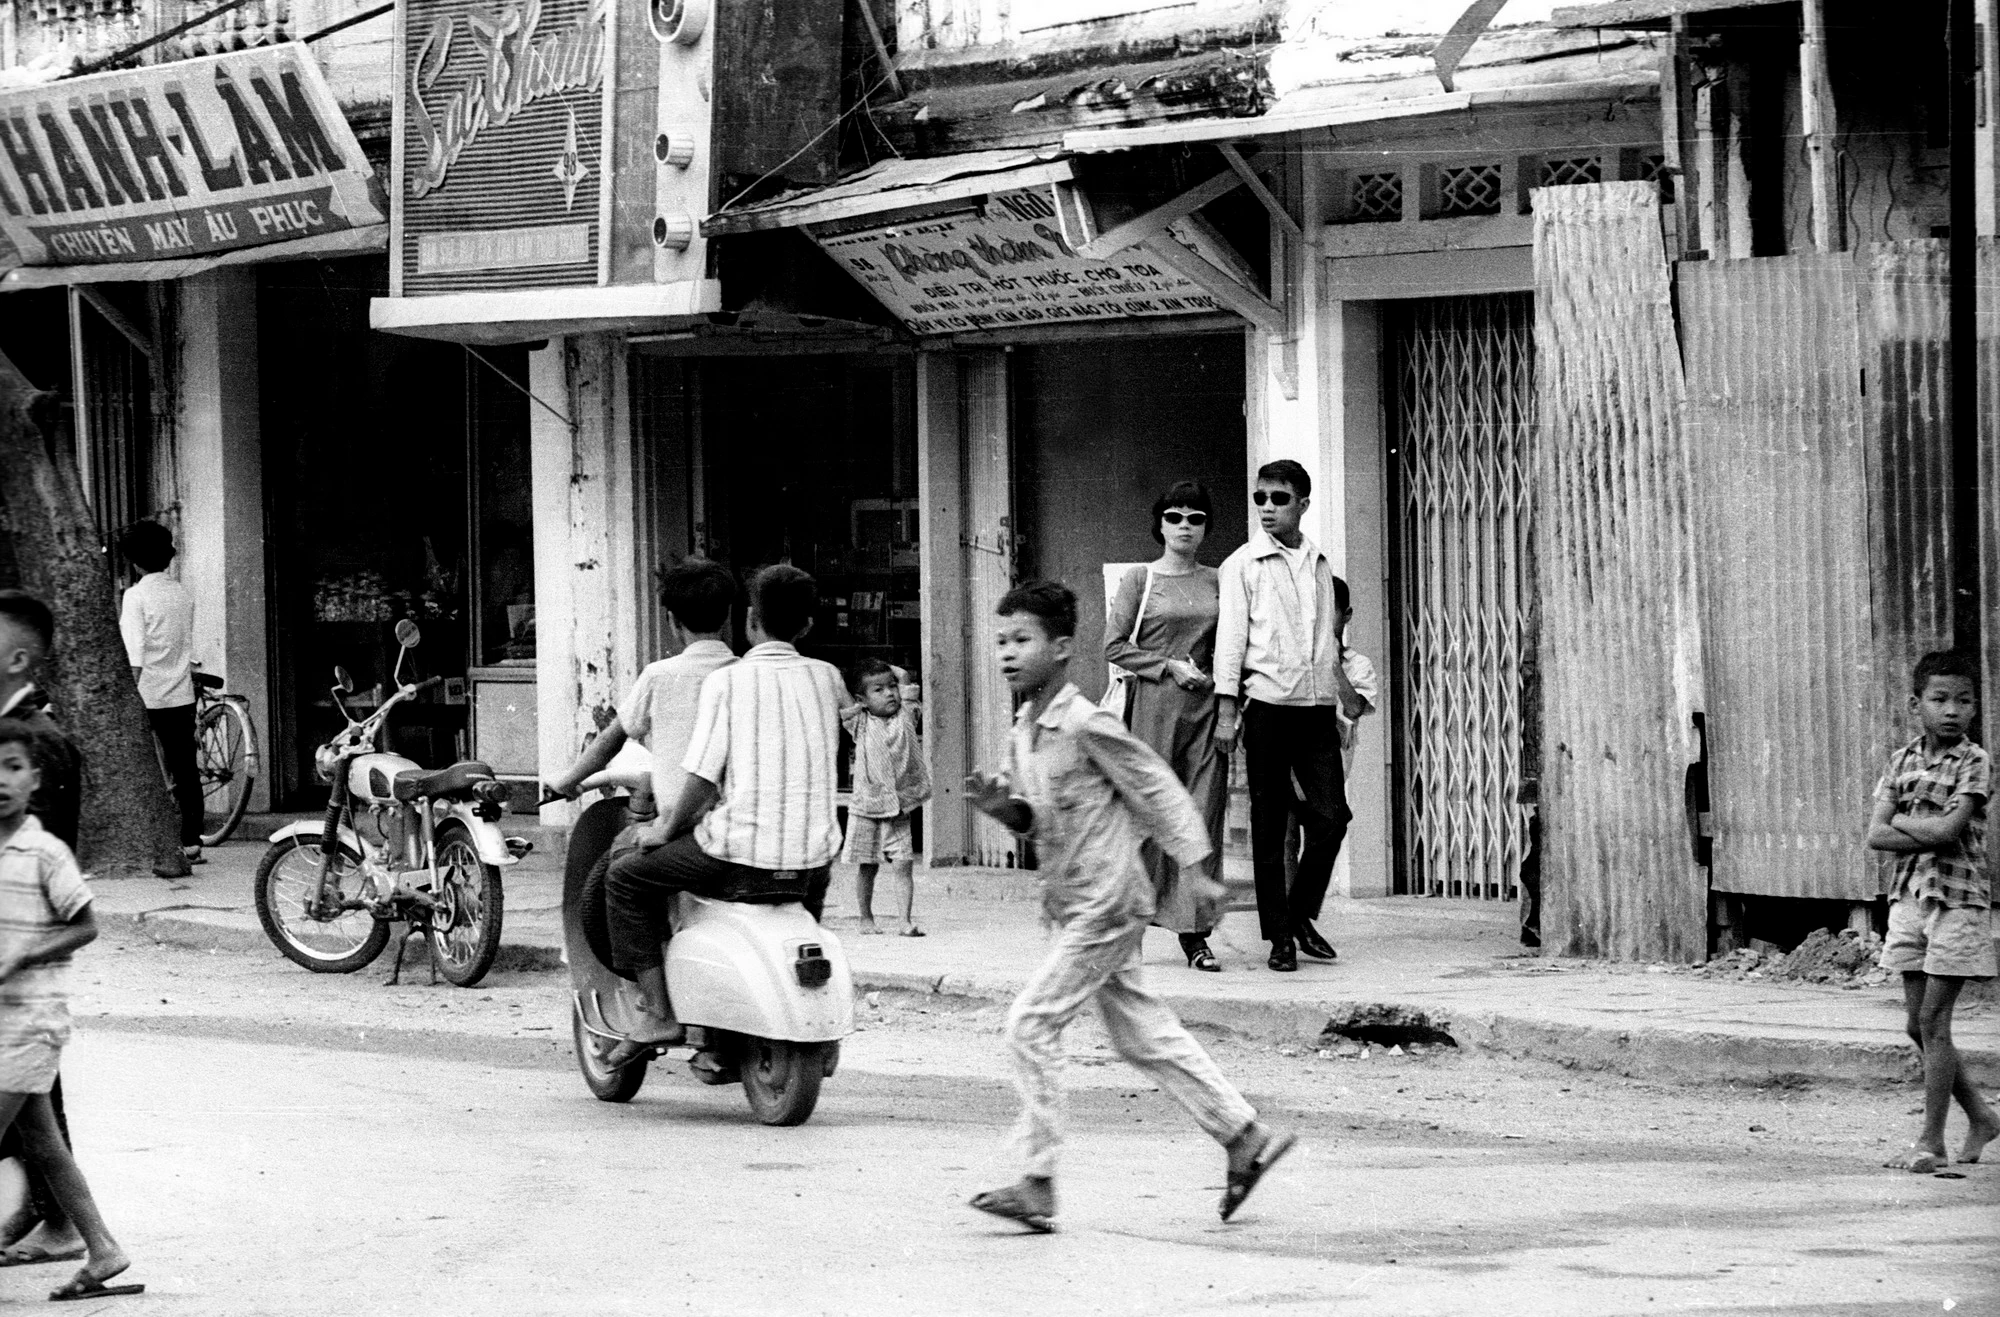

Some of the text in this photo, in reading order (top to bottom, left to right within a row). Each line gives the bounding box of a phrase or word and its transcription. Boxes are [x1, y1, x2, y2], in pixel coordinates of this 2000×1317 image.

[563, 151, 577, 177] 98
[51, 200, 324, 256] CHUYÊN MAY ÂU PHỤC
[1122, 264, 1163, 277] TOA
[1157, 298, 1187, 311] XIN
